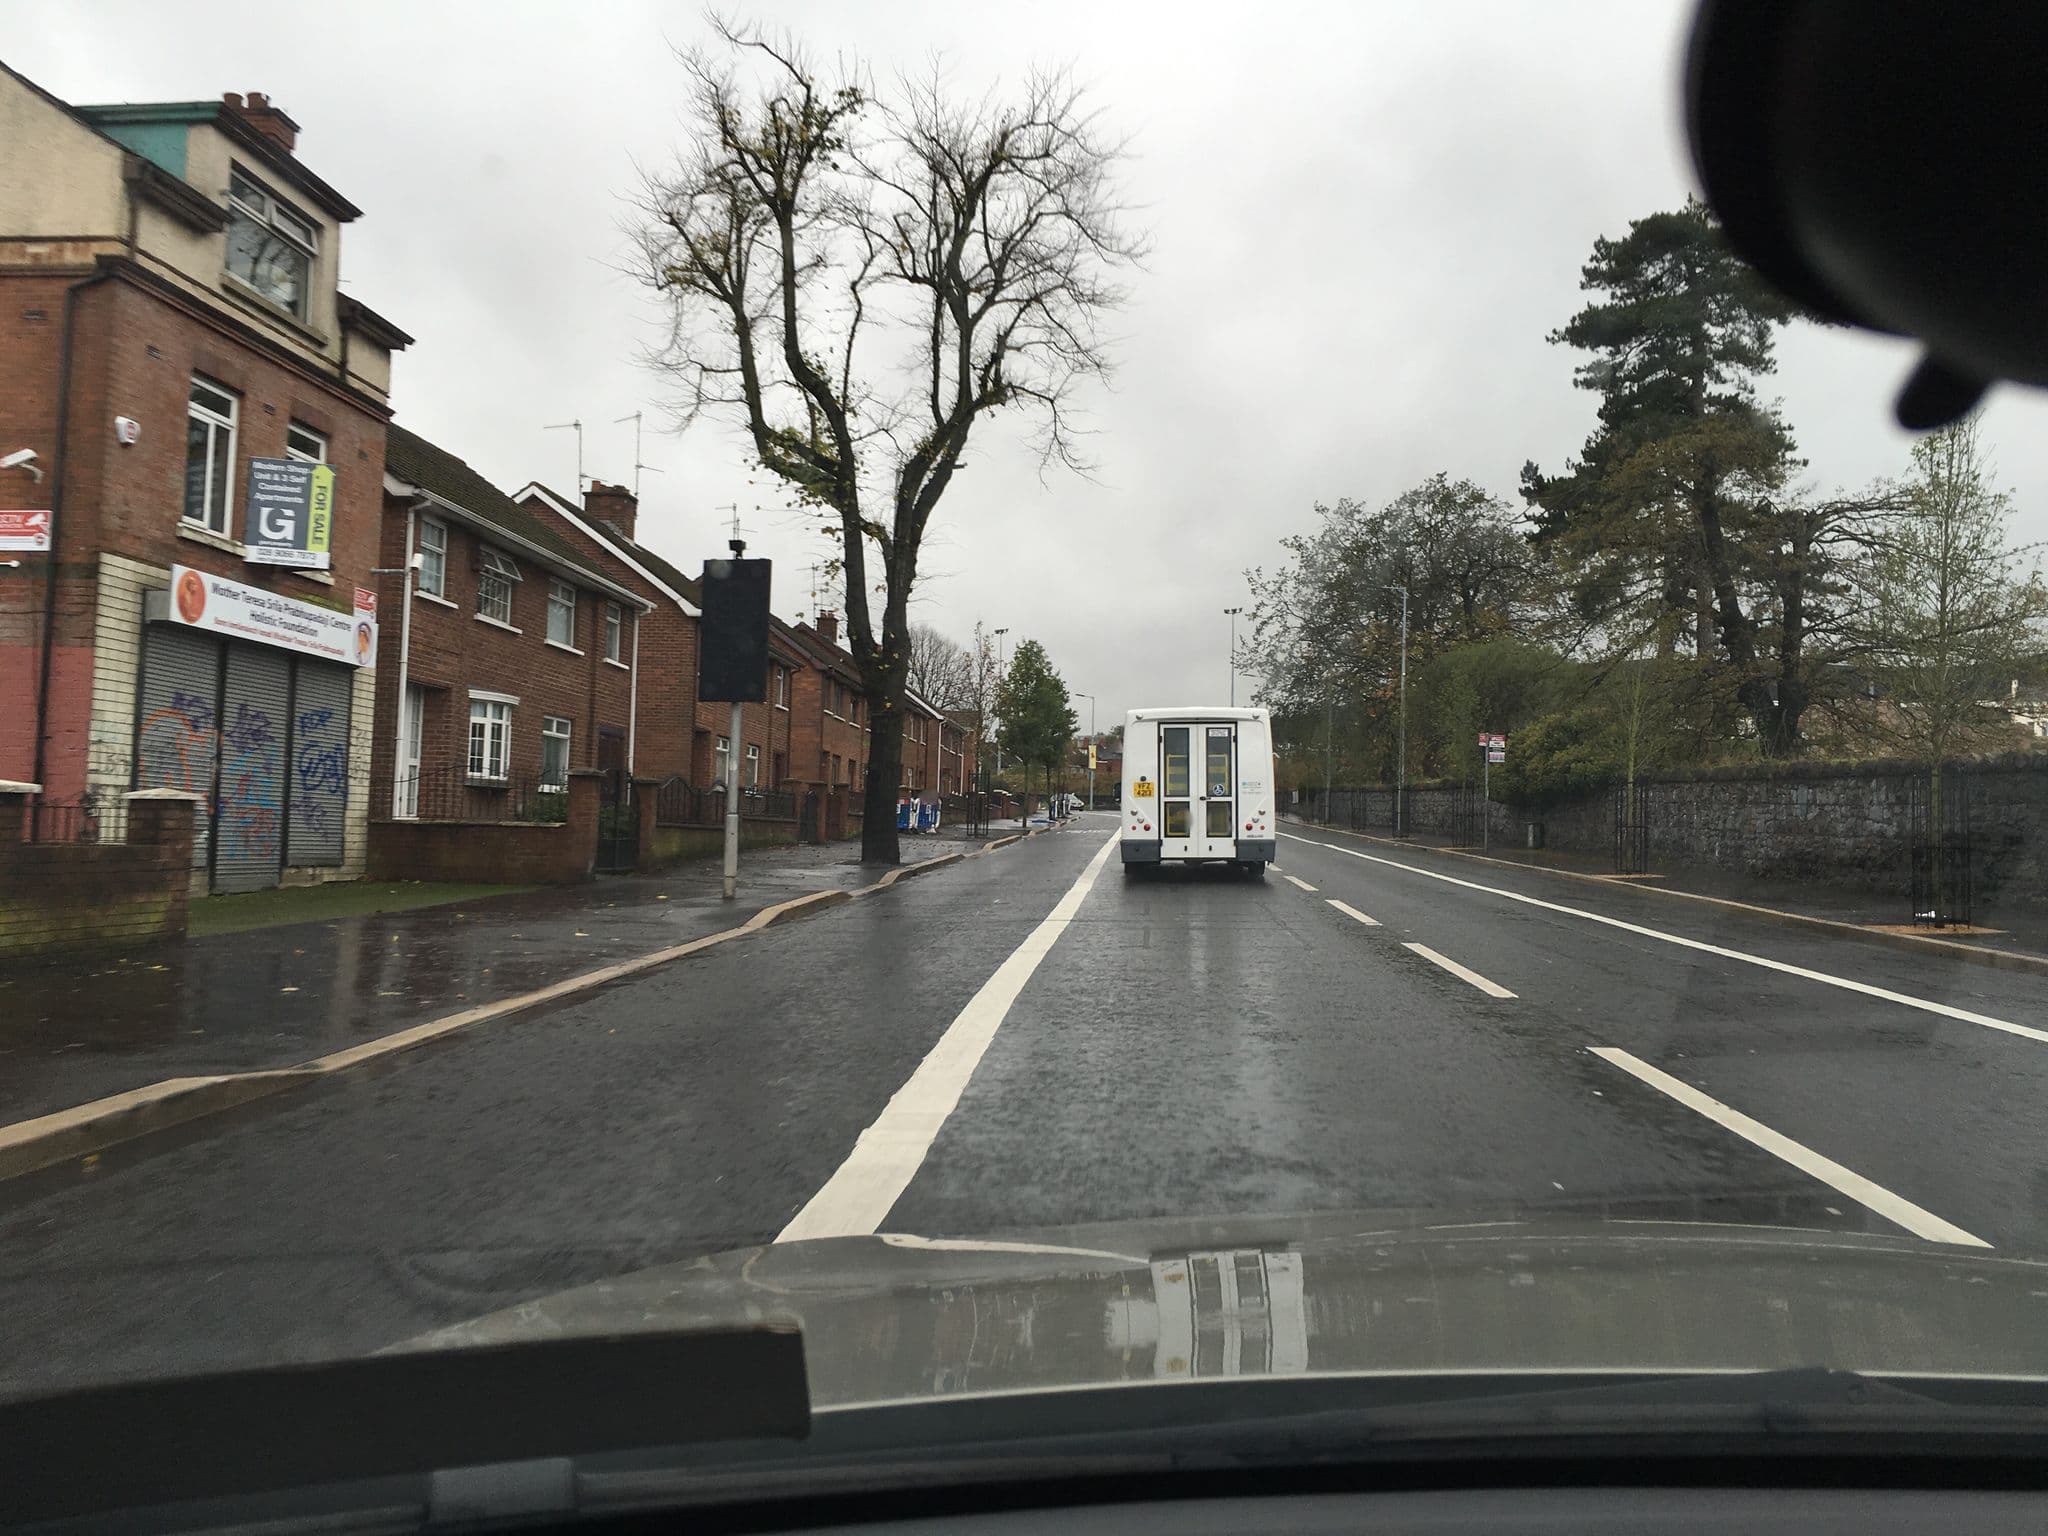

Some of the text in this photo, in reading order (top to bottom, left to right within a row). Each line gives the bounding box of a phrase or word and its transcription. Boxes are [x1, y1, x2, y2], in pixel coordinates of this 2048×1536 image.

[252, 461, 310, 475] Modern Shop
[253, 471, 272, 481] Unit
[289, 475, 307, 484] Self
[254, 492, 305, 504] Apartments
[257, 482, 303, 493] Contained
[258, 506, 296, 541] G
[312, 485, 328, 546] FOR SALE
[211, 582, 240, 600] Mother
[241, 590, 266, 608] Teresa
[330, 616, 352, 632] Centre
[250, 609, 277, 627] Holistic
[278, 617, 318, 638] Foundation
